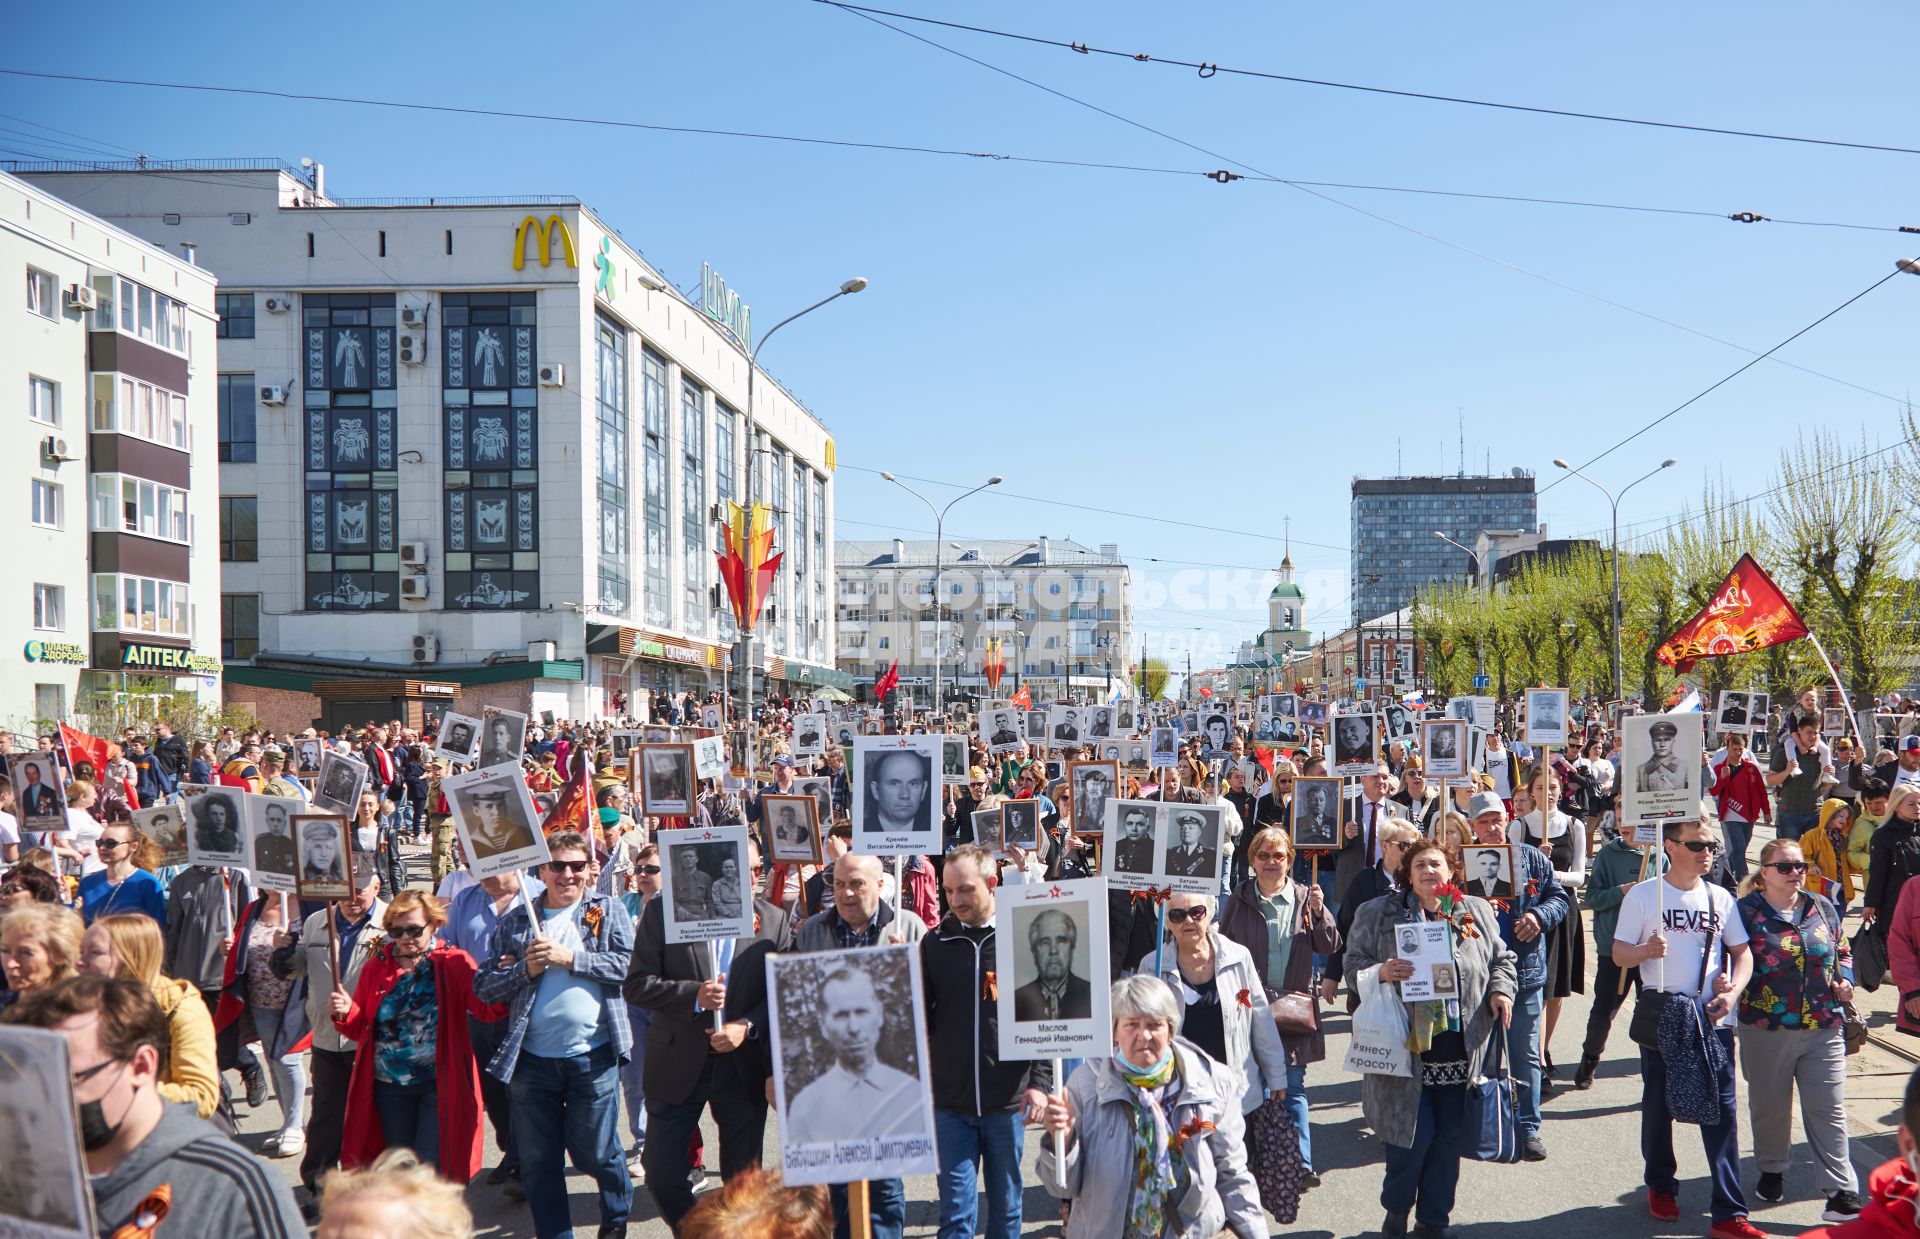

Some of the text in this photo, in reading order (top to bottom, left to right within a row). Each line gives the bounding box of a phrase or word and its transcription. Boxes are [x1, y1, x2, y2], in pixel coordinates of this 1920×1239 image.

[702, 261, 752, 358] ЦУМ
[43, 641, 82, 652] ПЛАНЕТА
[44, 652, 88, 661] ЗДОРОВЬЯ
[124, 645, 193, 668] АПТЕКА
[1662, 909, 1720, 931] NEVER
[1038, 1024, 1068, 1032] Маслов
[1015, 1034, 1093, 1044] Геннадий Иванович
[1353, 1041, 1392, 1059] #янесу
[1350, 1057, 1397, 1074] красоту
[784, 1137, 932, 1172] Бабушкин Алексей Дмитриевич
